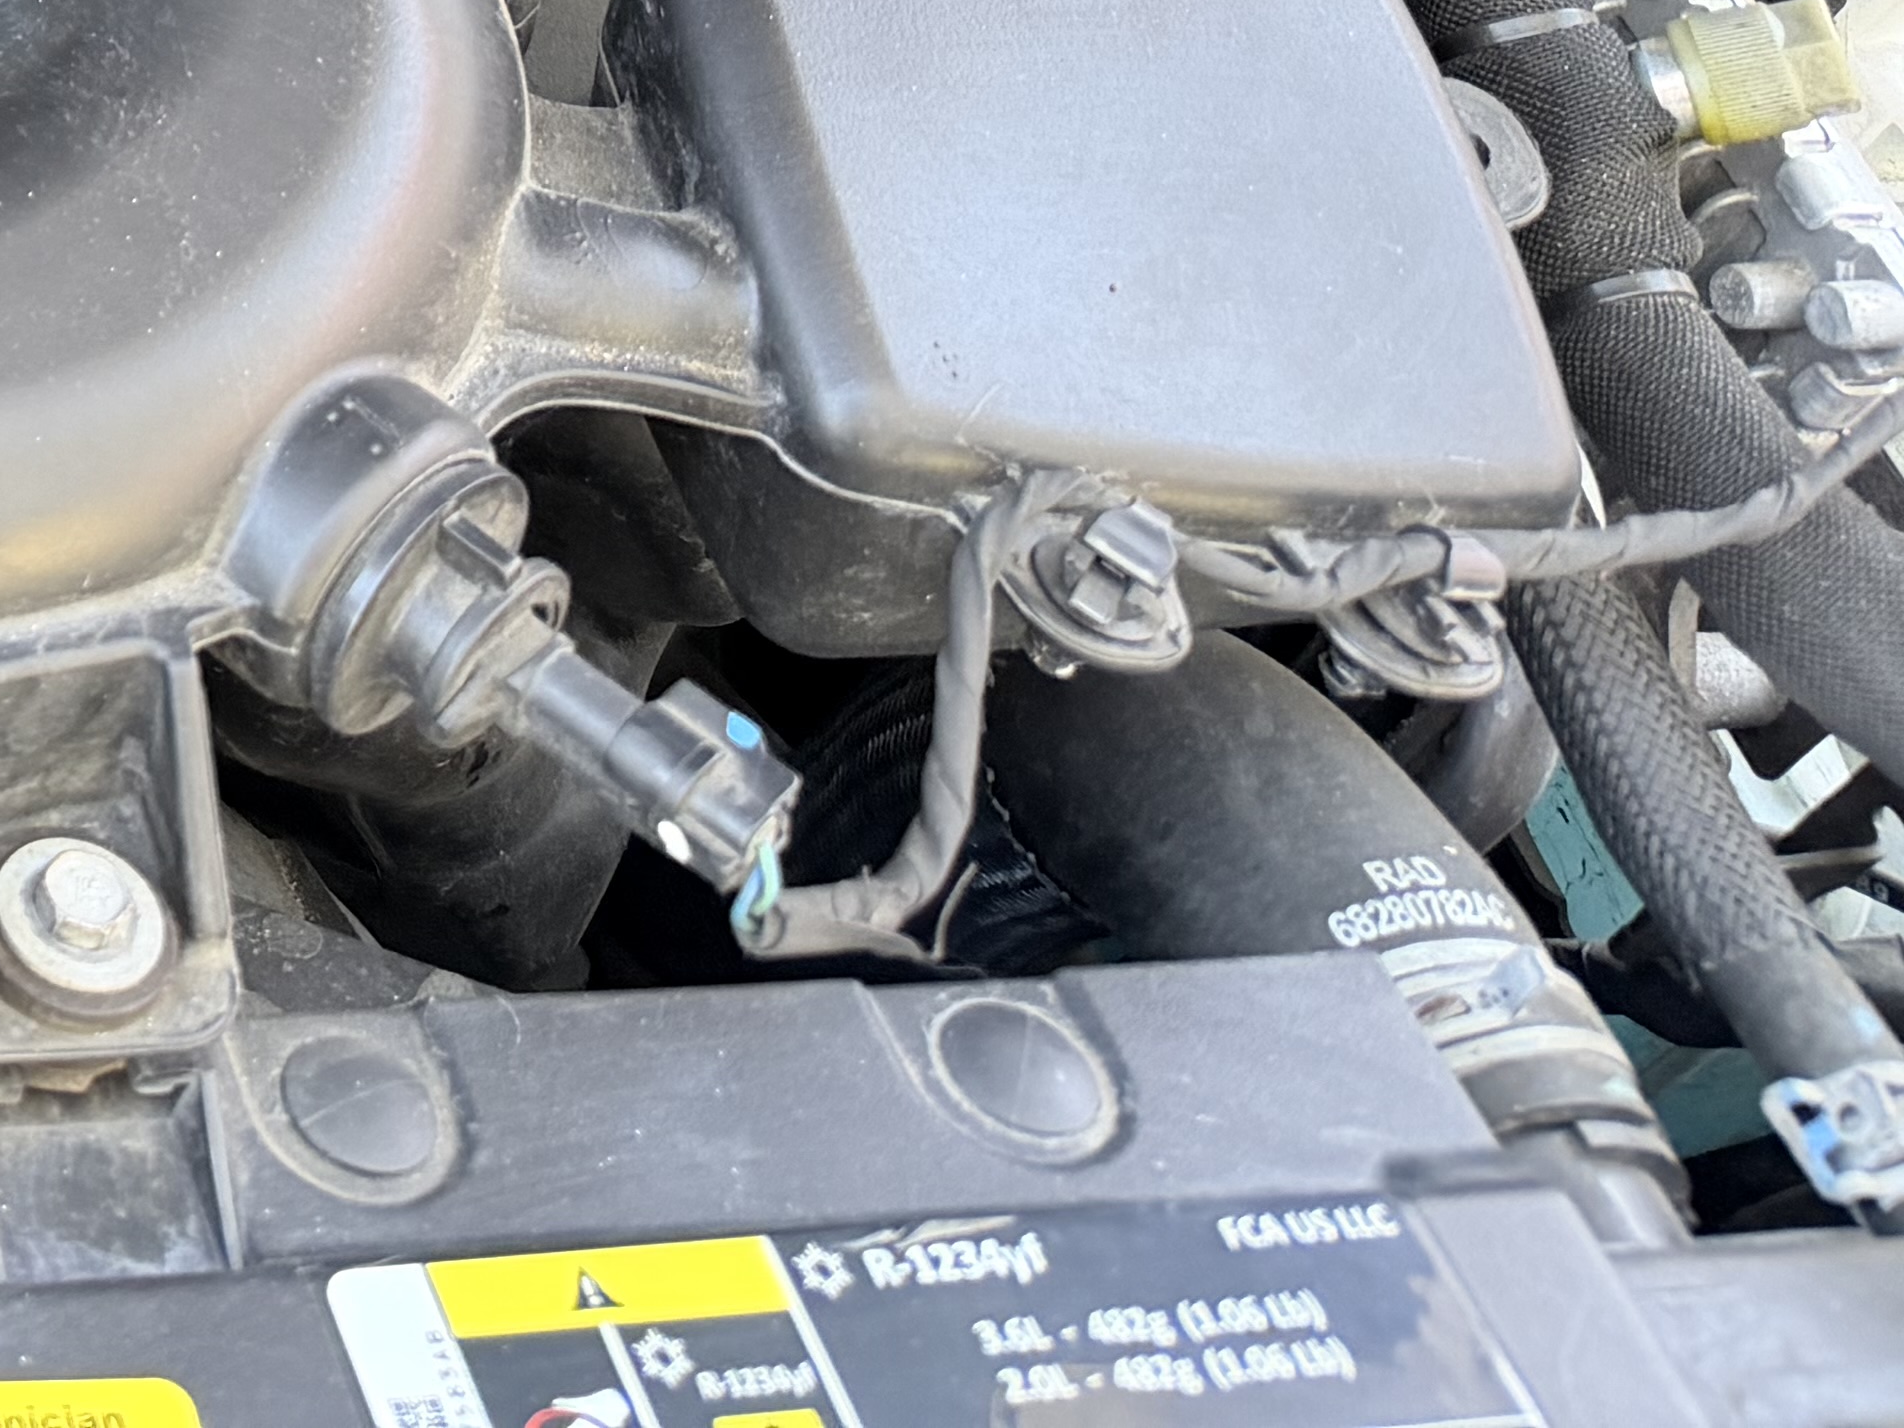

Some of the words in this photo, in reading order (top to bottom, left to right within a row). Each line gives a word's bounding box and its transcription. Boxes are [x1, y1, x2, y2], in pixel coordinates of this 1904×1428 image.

[1361, 855, 1448, 892] RAD
[1327, 888, 1517, 947] 68280782AC
[1217, 1212, 1291, 1252] FCA
[1284, 1207, 1339, 1244] US
[1333, 1203, 1401, 1240] LLC
[862, 1231, 1049, 1289] R-1234yf
